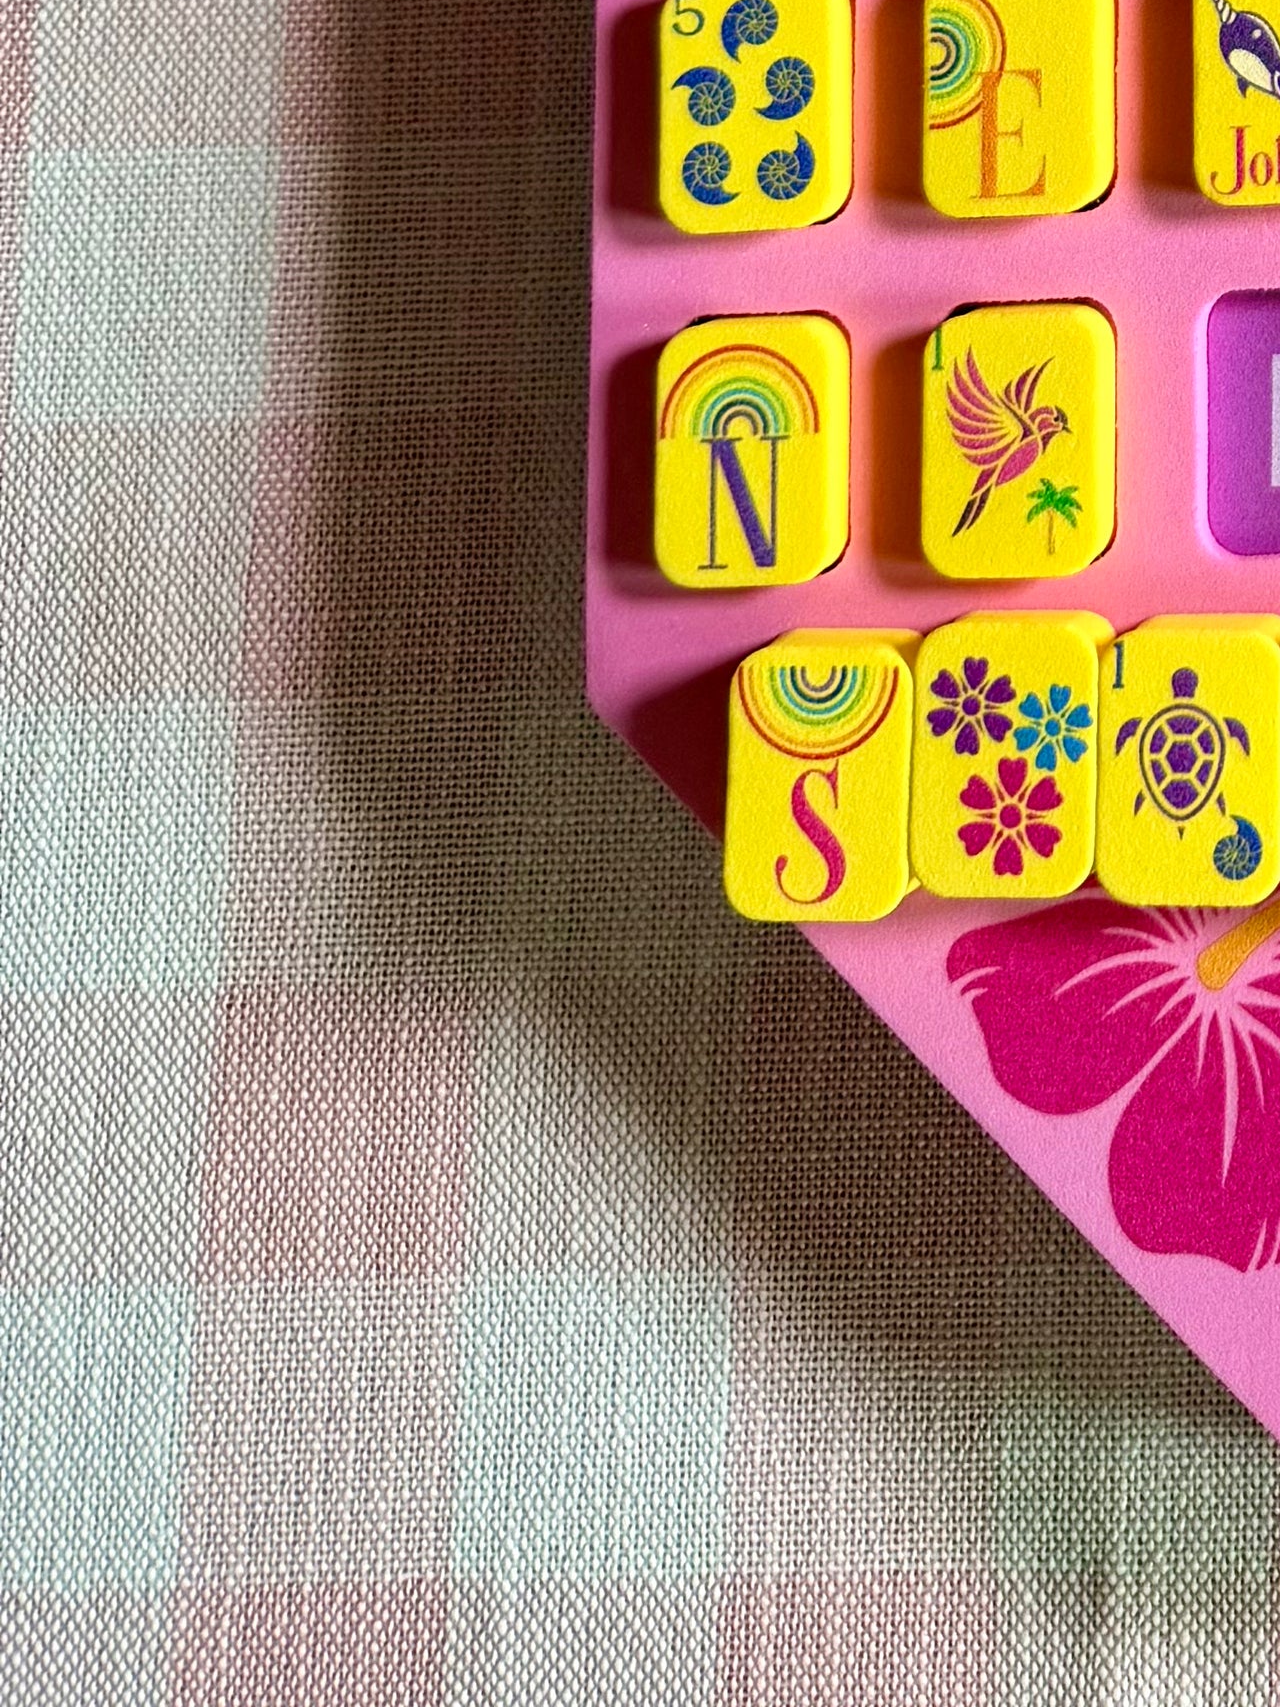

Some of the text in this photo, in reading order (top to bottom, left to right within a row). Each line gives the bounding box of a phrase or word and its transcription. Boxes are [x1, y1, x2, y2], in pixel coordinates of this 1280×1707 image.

[969, 68, 1046, 200] E
[698, 436, 782, 570] N
[1111, 642, 1125, 689] 1
[775, 763, 846, 906] S
